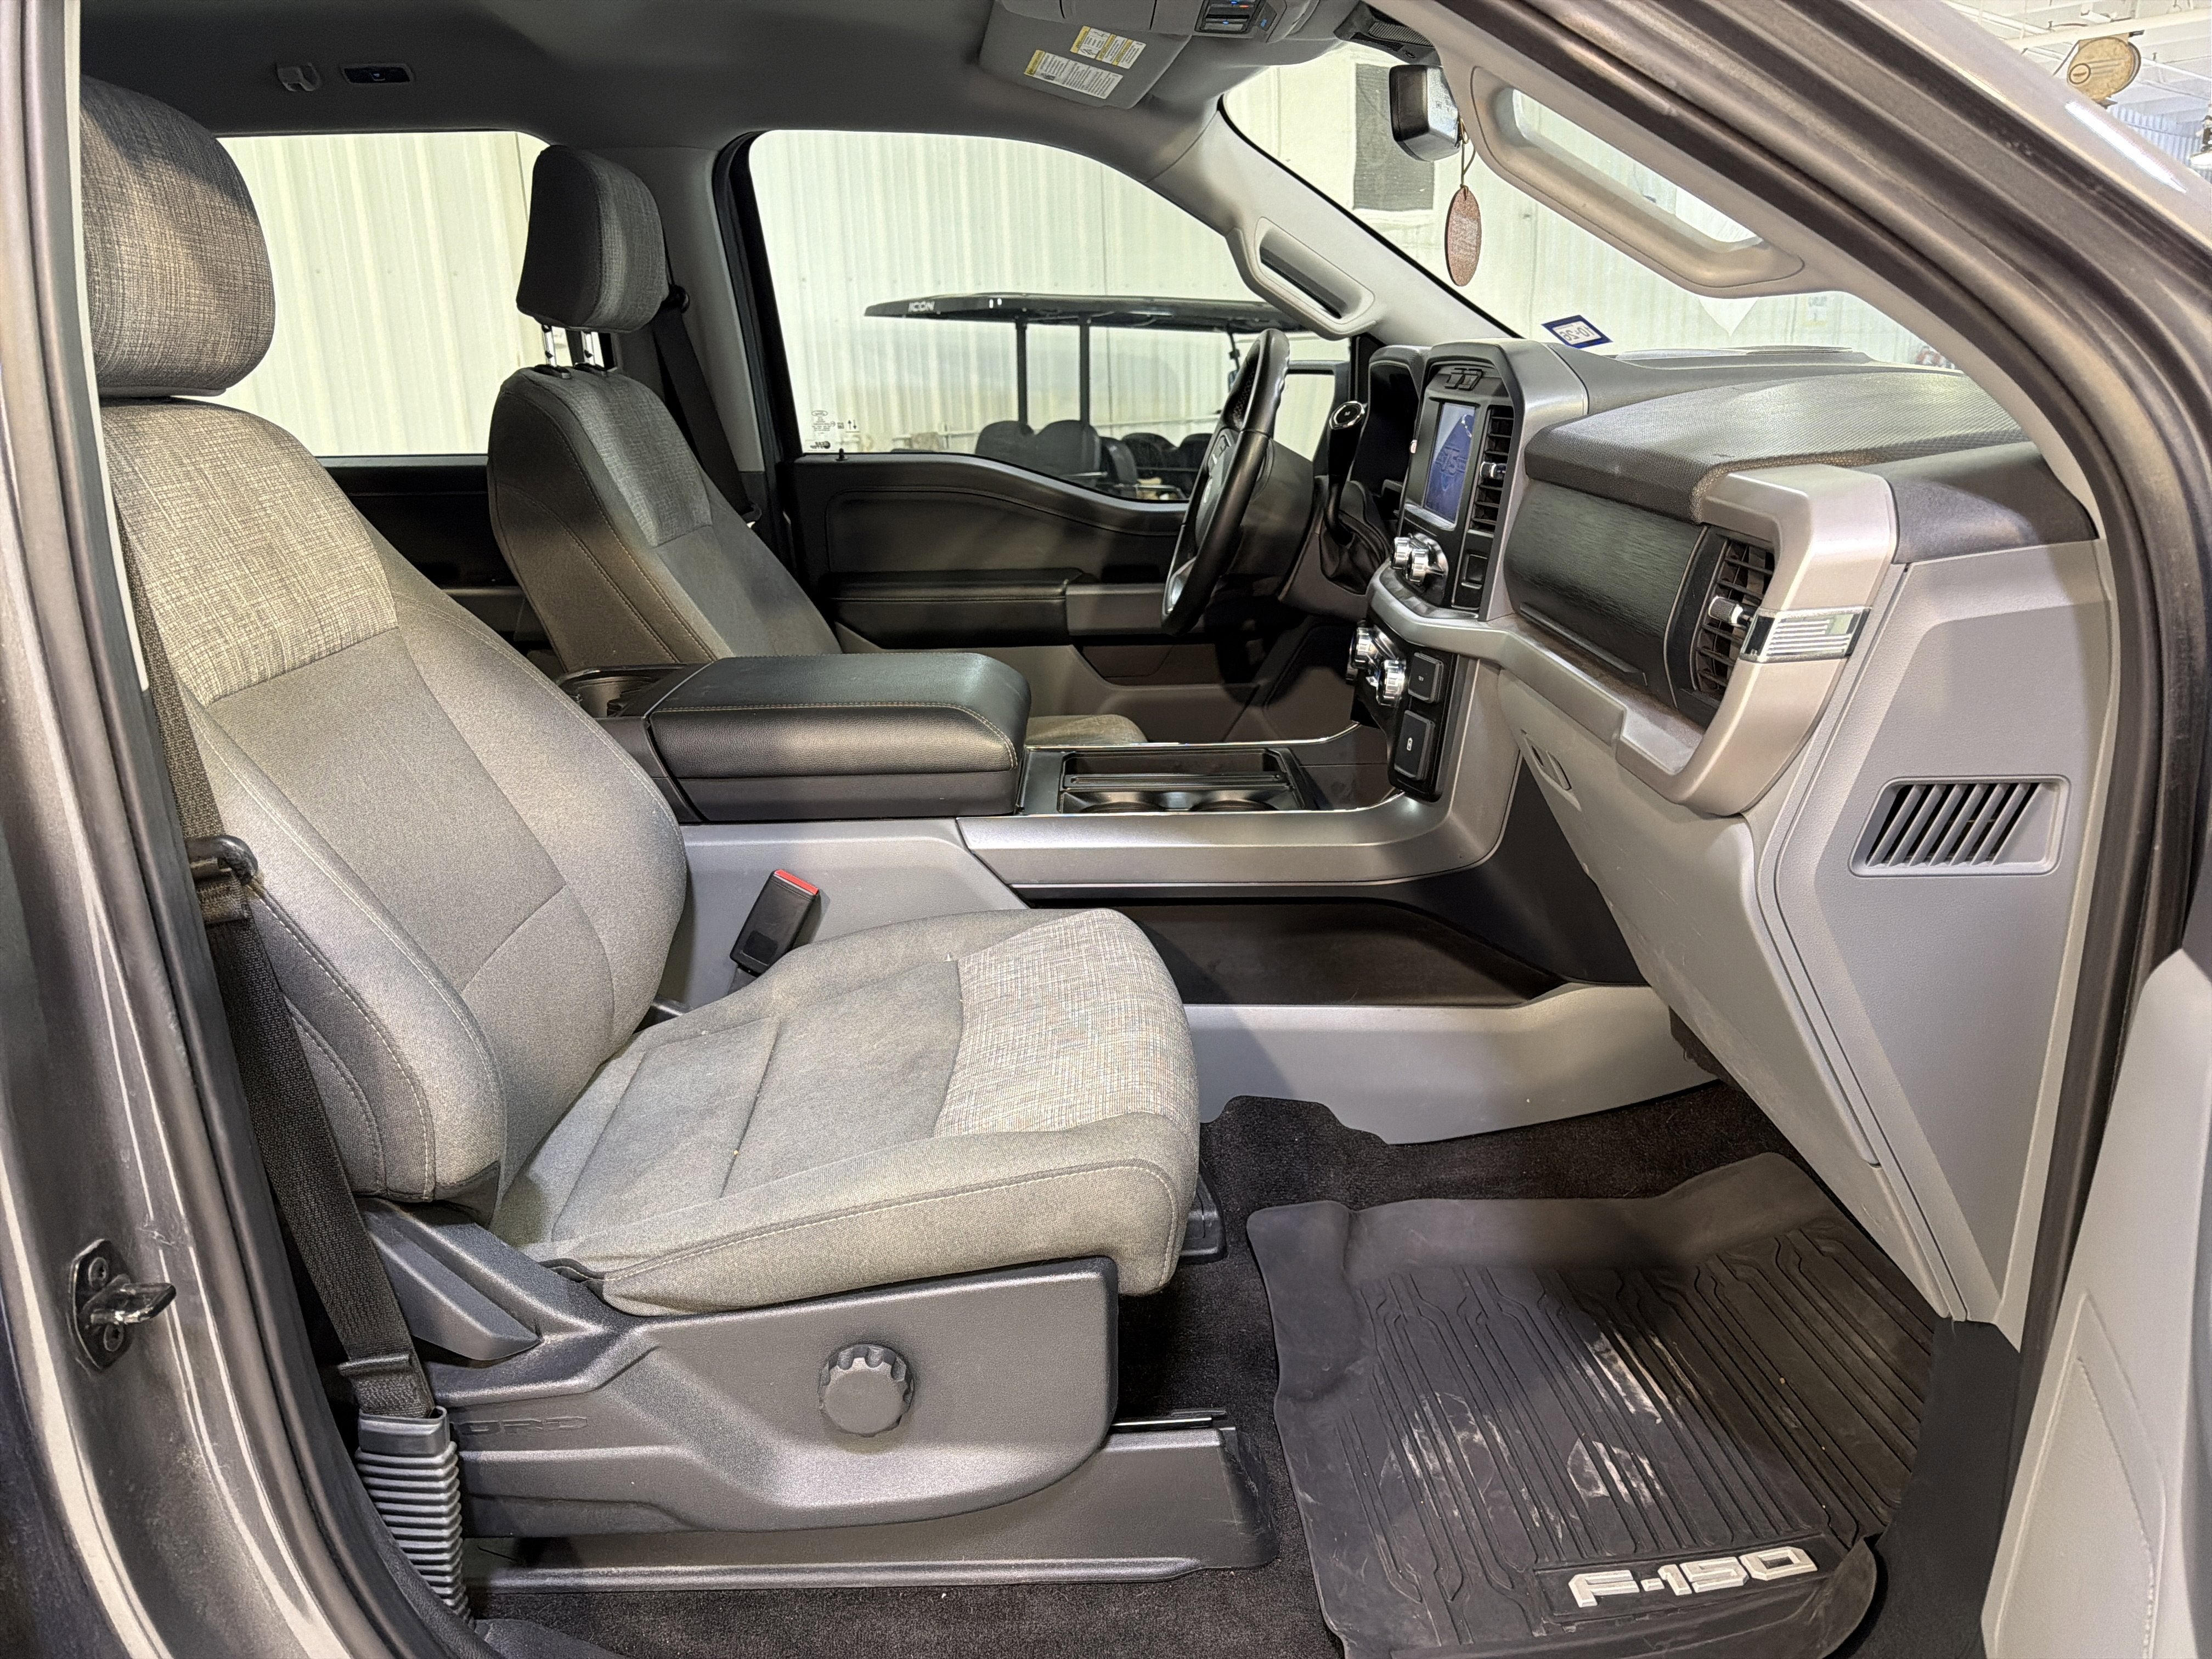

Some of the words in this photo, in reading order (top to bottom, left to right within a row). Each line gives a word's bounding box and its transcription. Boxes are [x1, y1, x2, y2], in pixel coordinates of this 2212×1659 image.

[909, 301, 935, 312] ICON
[459, 1416, 589, 1435] ORD
[1568, 1546, 1818, 1607] F-150
